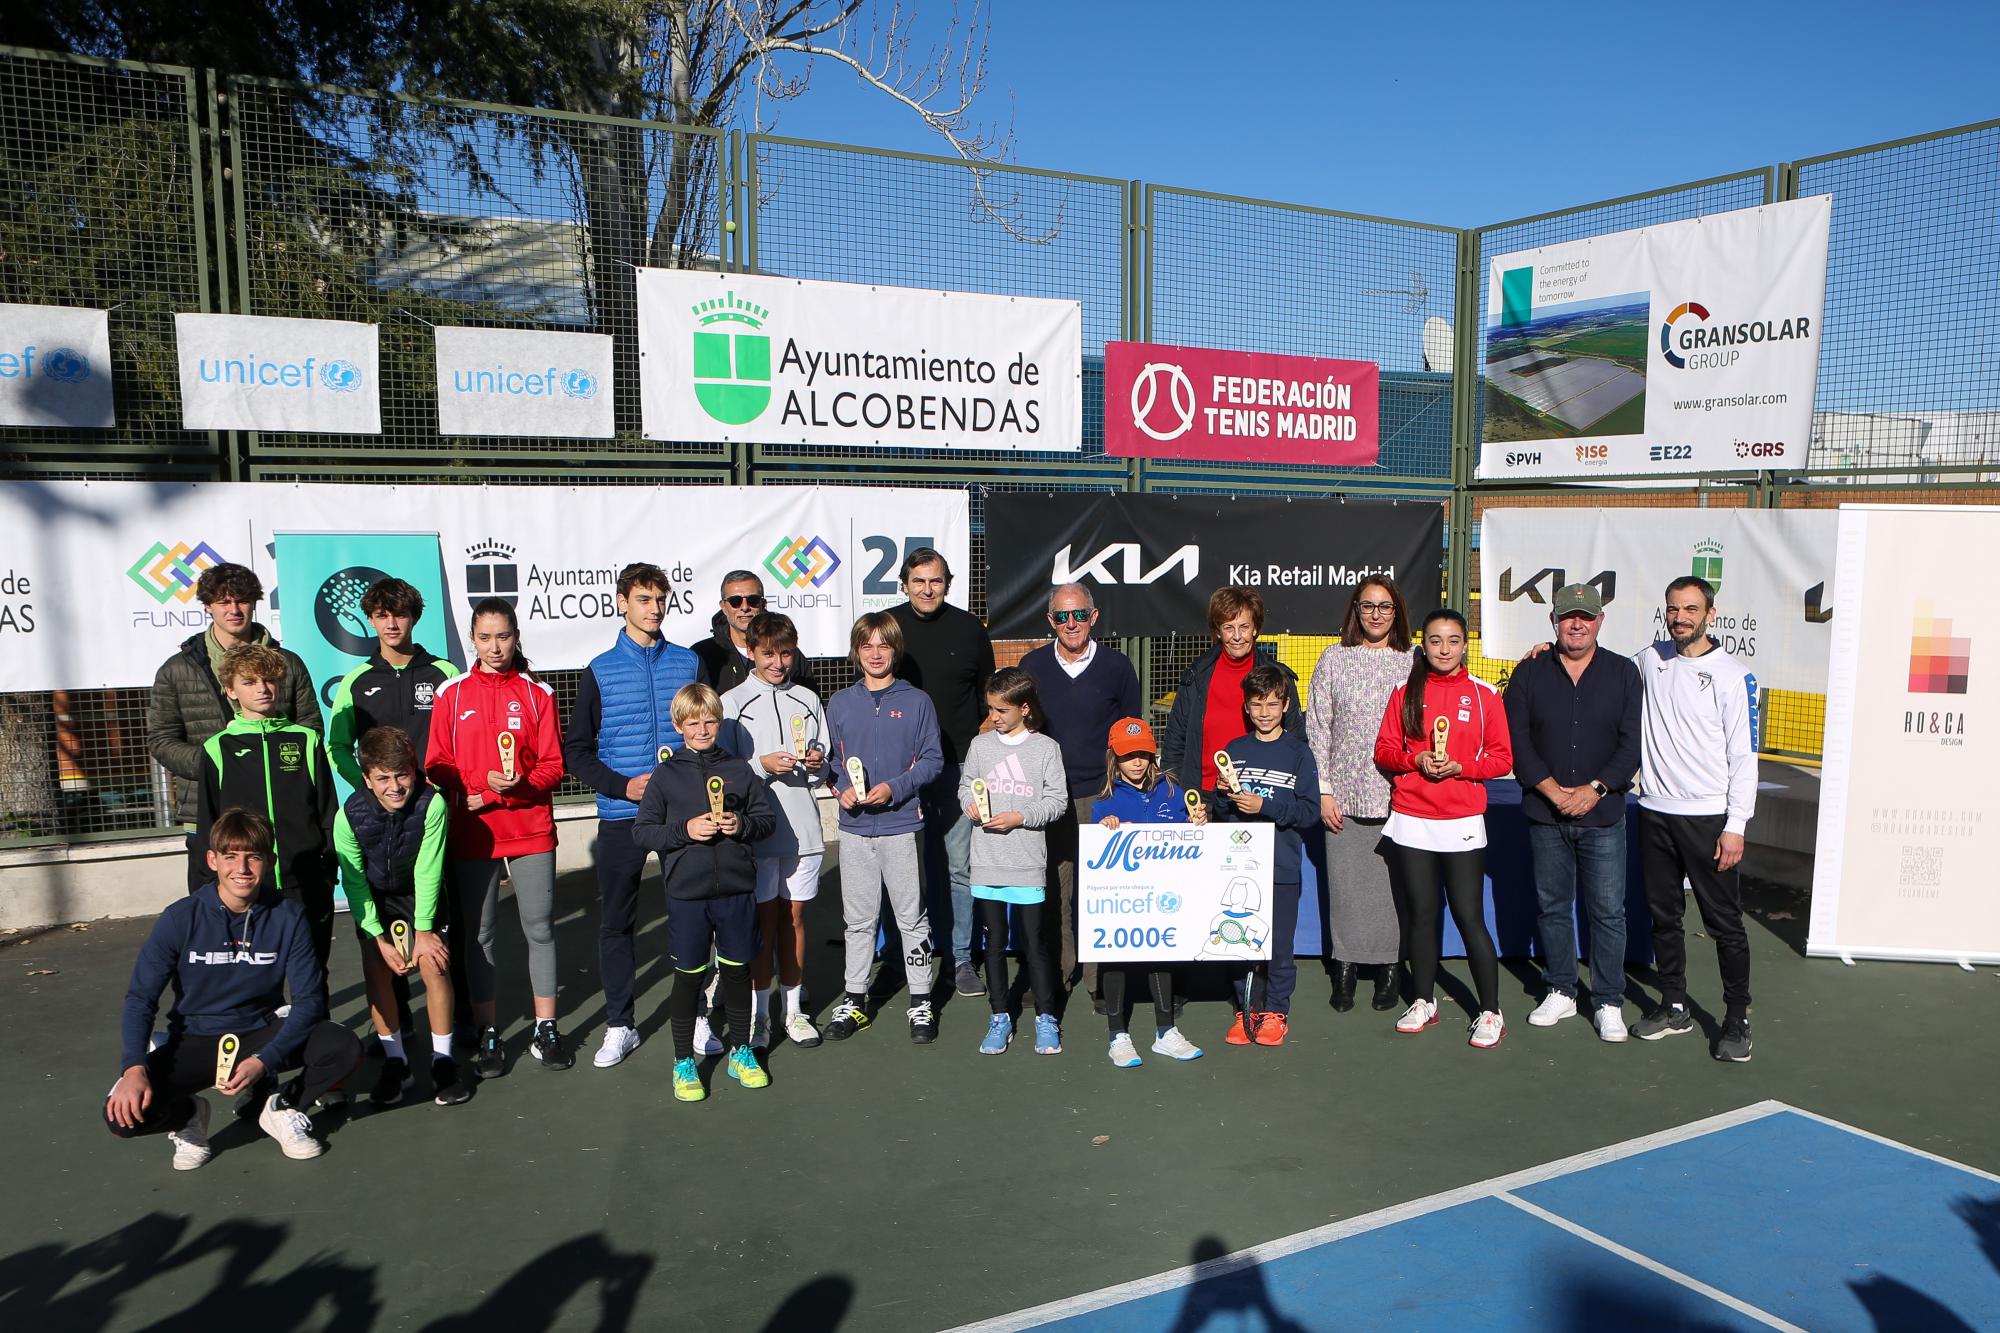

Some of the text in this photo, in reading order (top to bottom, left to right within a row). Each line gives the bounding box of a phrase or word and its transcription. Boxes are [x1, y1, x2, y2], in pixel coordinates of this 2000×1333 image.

[1540, 260, 1579, 274] Committed
[1539, 272, 1587, 288] the energy of
[1539, 290, 1574, 302] tomorrow
[1679, 317, 1810, 350] GRANSOLAR
[778, 337, 1040, 387] Ayuntamiento de
[1689, 350, 1740, 370] GROUP
[199, 354, 316, 388] unicef
[454, 365, 557, 395] unicef
[1212, 375, 1351, 411] FEDERACIÓN
[1673, 393, 1787, 412] www.gransolar.com
[780, 389, 1040, 434] ALCOBENDAS
[1203, 407, 1357, 442] TENIS MADRID
[1516, 452, 1541, 466] PVH
[1663, 445, 1692, 460] E22
[1751, 442, 1785, 457] GRS
[1, 569, 31, 595] de
[671, 561, 693, 583] de
[1229, 565, 1262, 586] Kia
[1267, 565, 1323, 586] Retail
[765, 594, 842, 609] FUNDAL
[1742, 613, 1756, 631] de
[1941, 737, 1963, 746] DESIGN
[1141, 829, 1204, 841] TORNEO
[1087, 830, 1204, 872] Menina
[1087, 892, 1154, 914] unicef
[1093, 927, 1177, 949] 2.000€
[189, 950, 278, 965] HEAD
